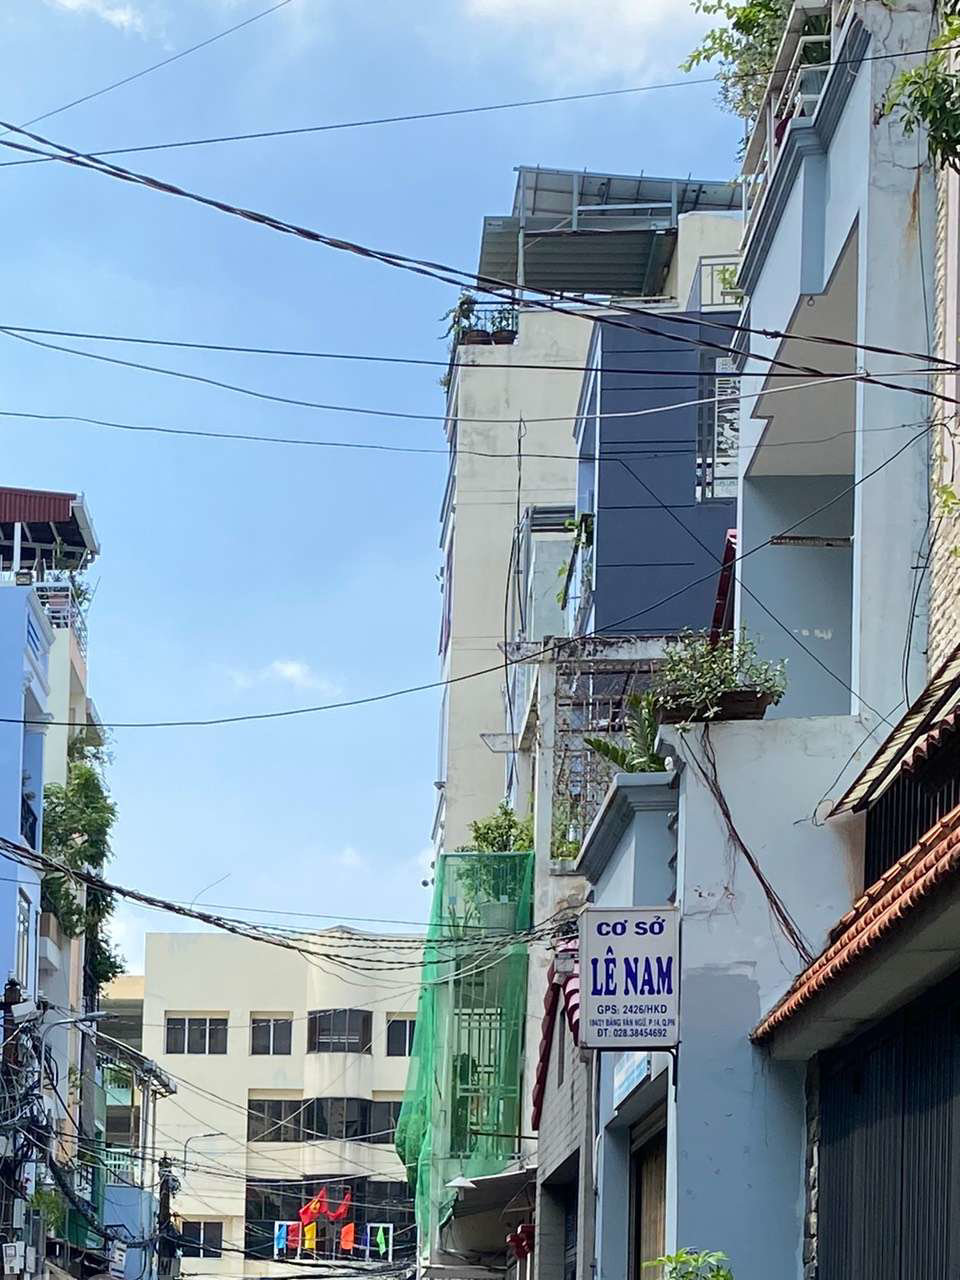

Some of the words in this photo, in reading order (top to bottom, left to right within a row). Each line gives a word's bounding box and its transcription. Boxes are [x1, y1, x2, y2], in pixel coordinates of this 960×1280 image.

[596, 919, 628, 936] CƠ
[634, 915, 666, 936] SỞ
[591, 945, 617, 996] LÊ
[624, 956, 673, 996] NAM
